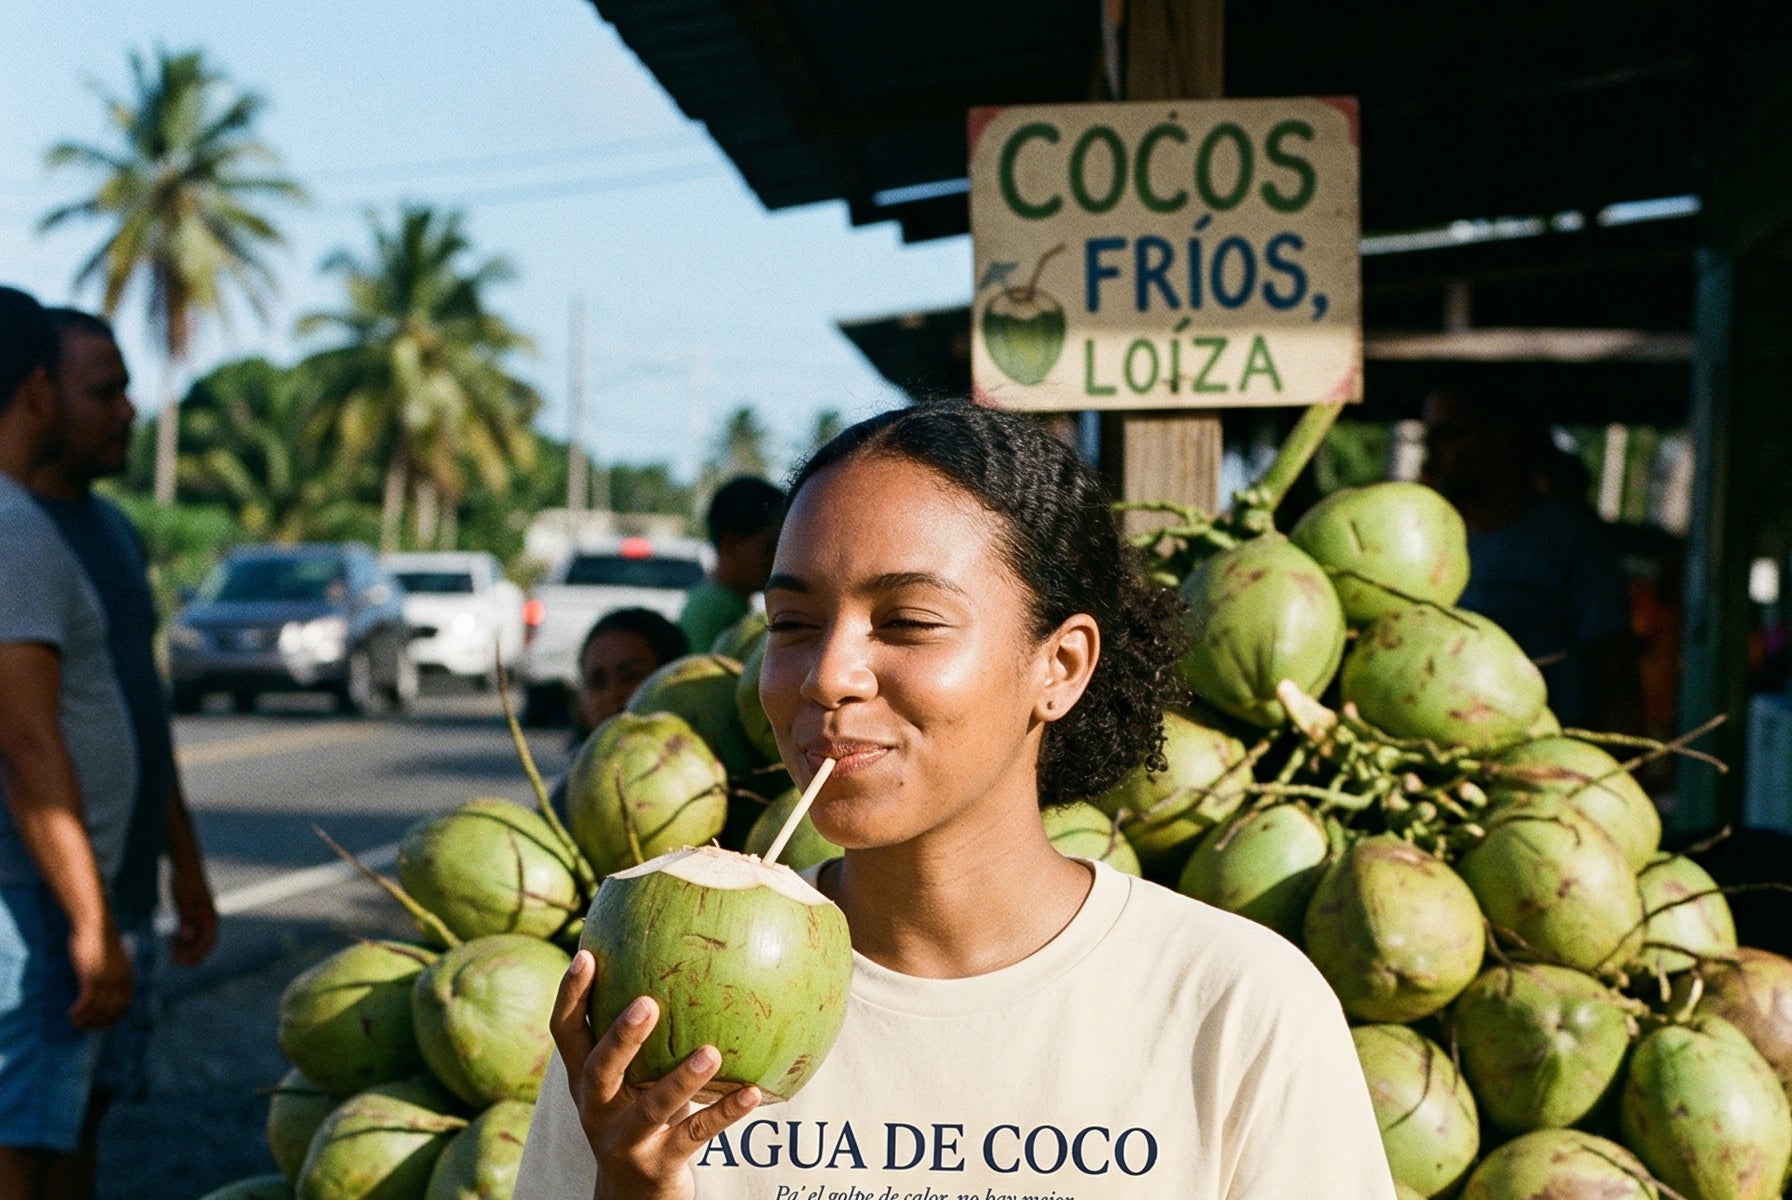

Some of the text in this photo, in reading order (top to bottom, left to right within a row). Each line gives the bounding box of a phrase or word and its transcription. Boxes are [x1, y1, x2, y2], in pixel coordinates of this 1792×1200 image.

[998, 119, 1318, 221] COCOS
[1084, 213, 1330, 322] FRÍOS,
[1085, 316, 1283, 396] LOÍZA
[696, 1119, 1159, 1176] AGUA DE COCO
